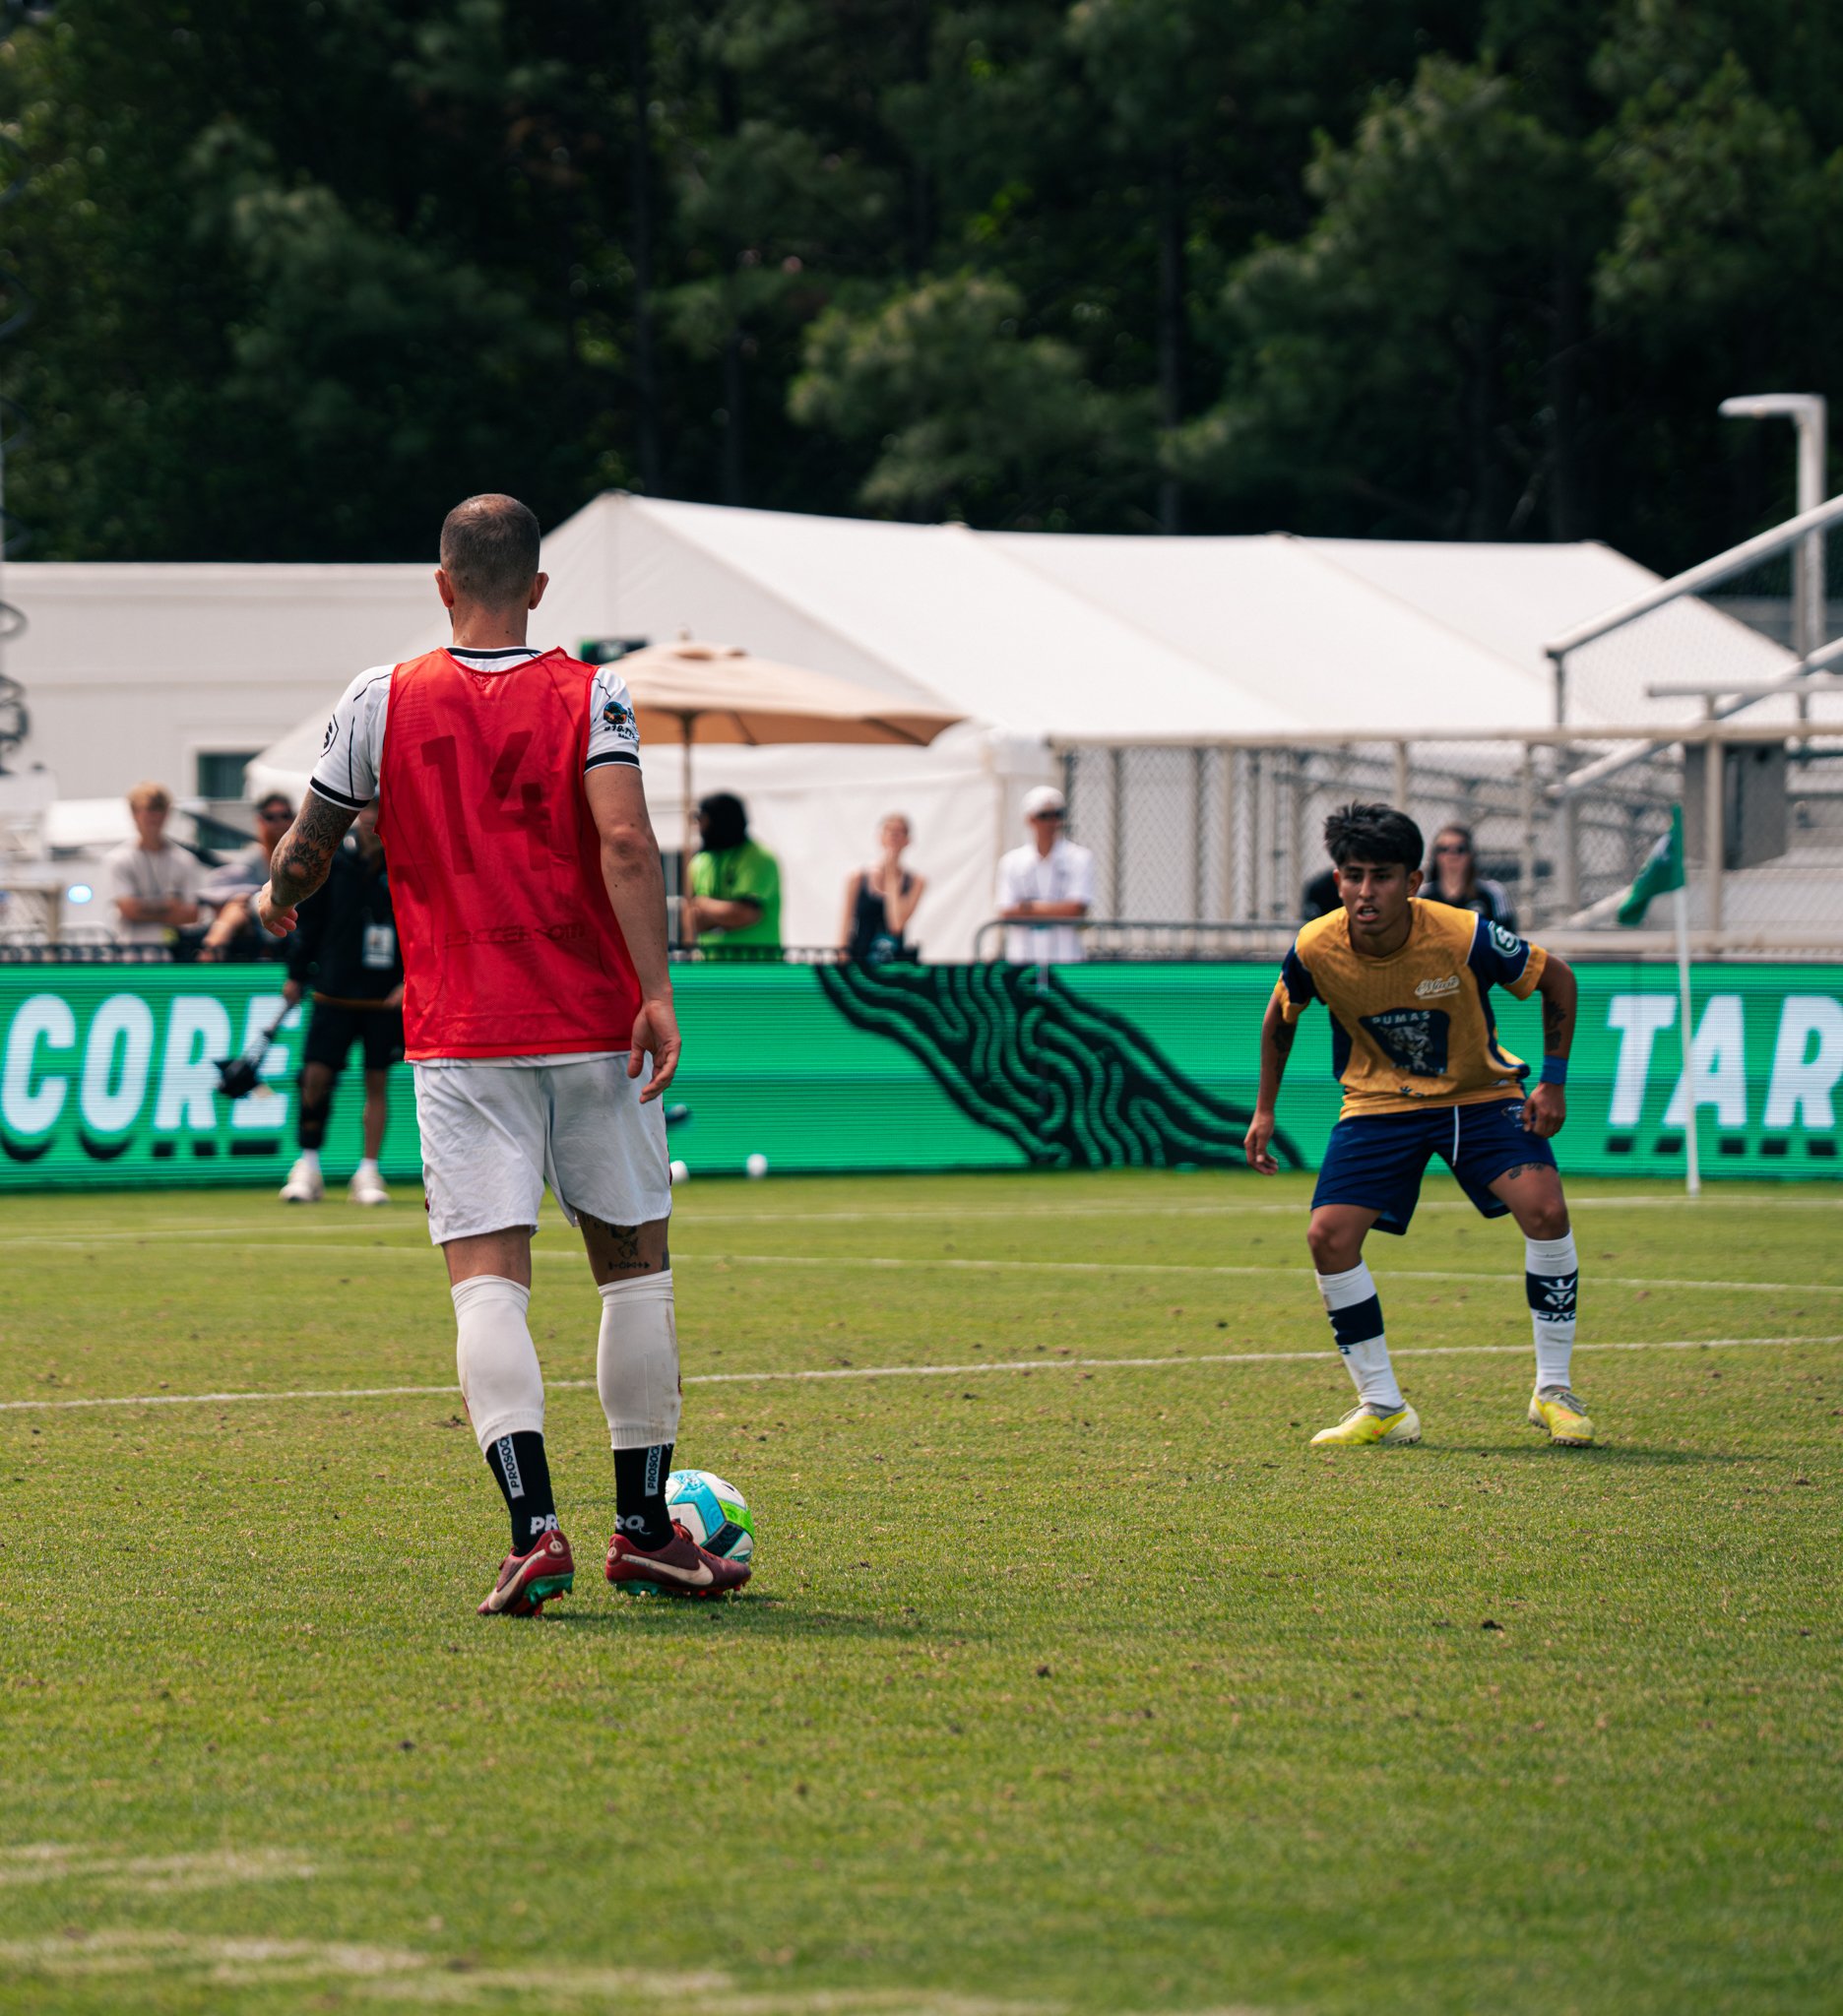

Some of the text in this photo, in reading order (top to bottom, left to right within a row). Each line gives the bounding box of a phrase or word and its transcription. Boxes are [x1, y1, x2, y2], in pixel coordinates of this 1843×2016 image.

[420, 730, 551, 875] 14
[2, 992, 302, 1134] CORE
[1370, 1010, 1431, 1025] PUMAS
[1606, 993, 1843, 1129] TAR
